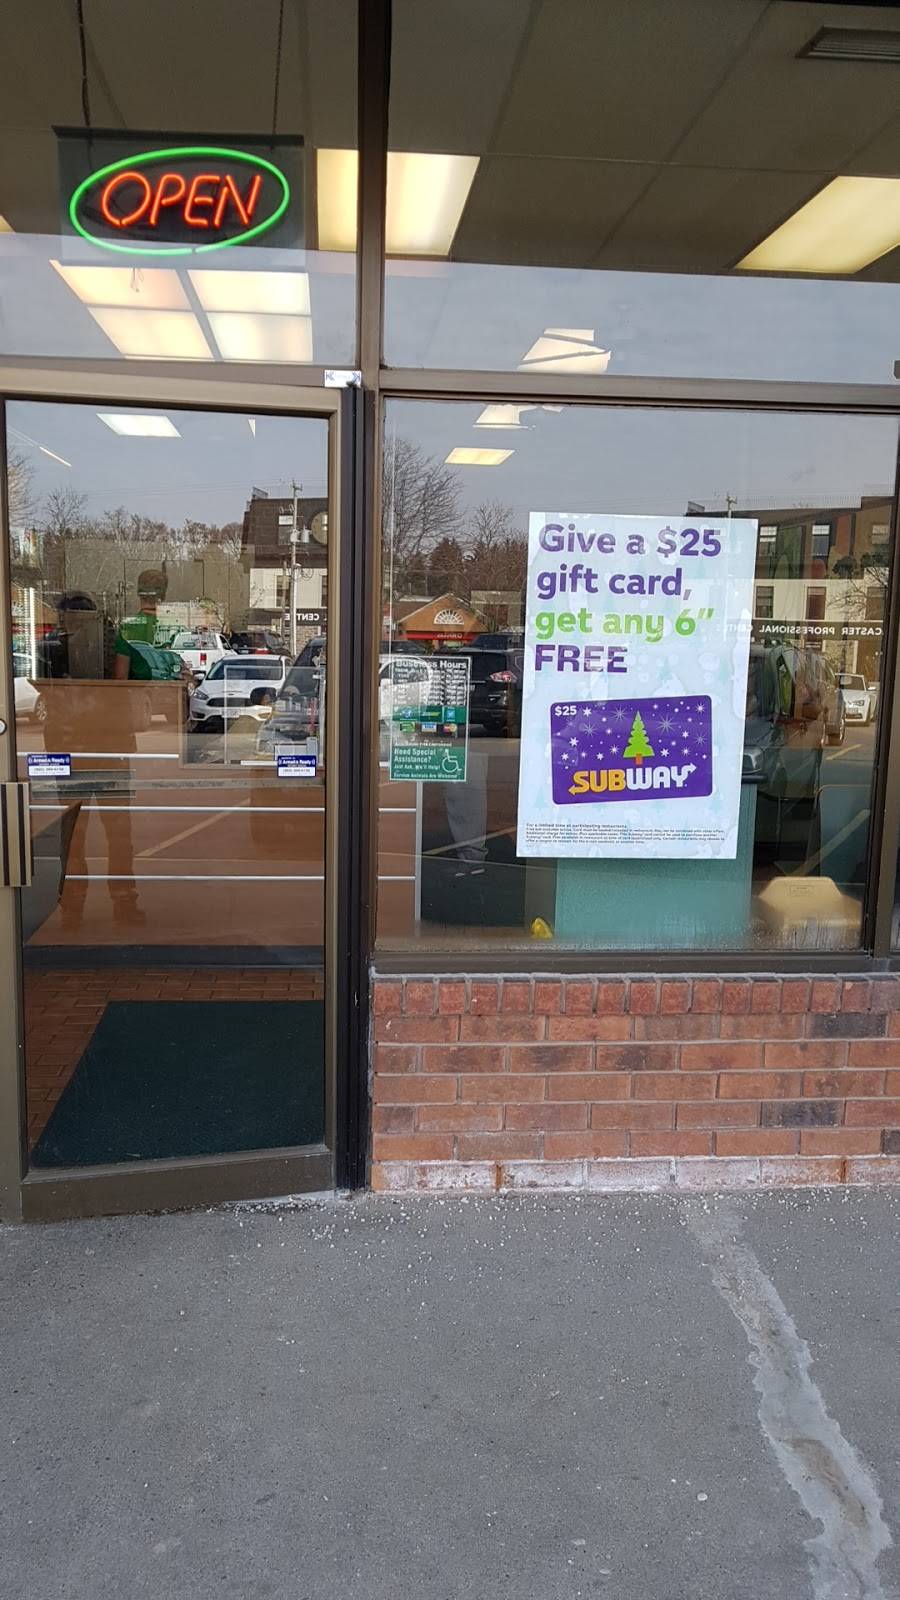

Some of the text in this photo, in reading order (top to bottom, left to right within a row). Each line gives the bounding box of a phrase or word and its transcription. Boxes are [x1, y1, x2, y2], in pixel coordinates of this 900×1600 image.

[101, 170, 262, 227] OPEN
[539, 523, 722, 559] Give a $25
[536, 563, 692, 601] gift card,
[534, 608, 593, 641] get
[602, 616, 664, 643] any
[439, 660, 468, 668] Hours
[534, 644, 629, 674] FREE
[554, 705, 578, 717] $25
[412, 748, 436, 756] Special
[567, 762, 698, 796] SUBWAY
